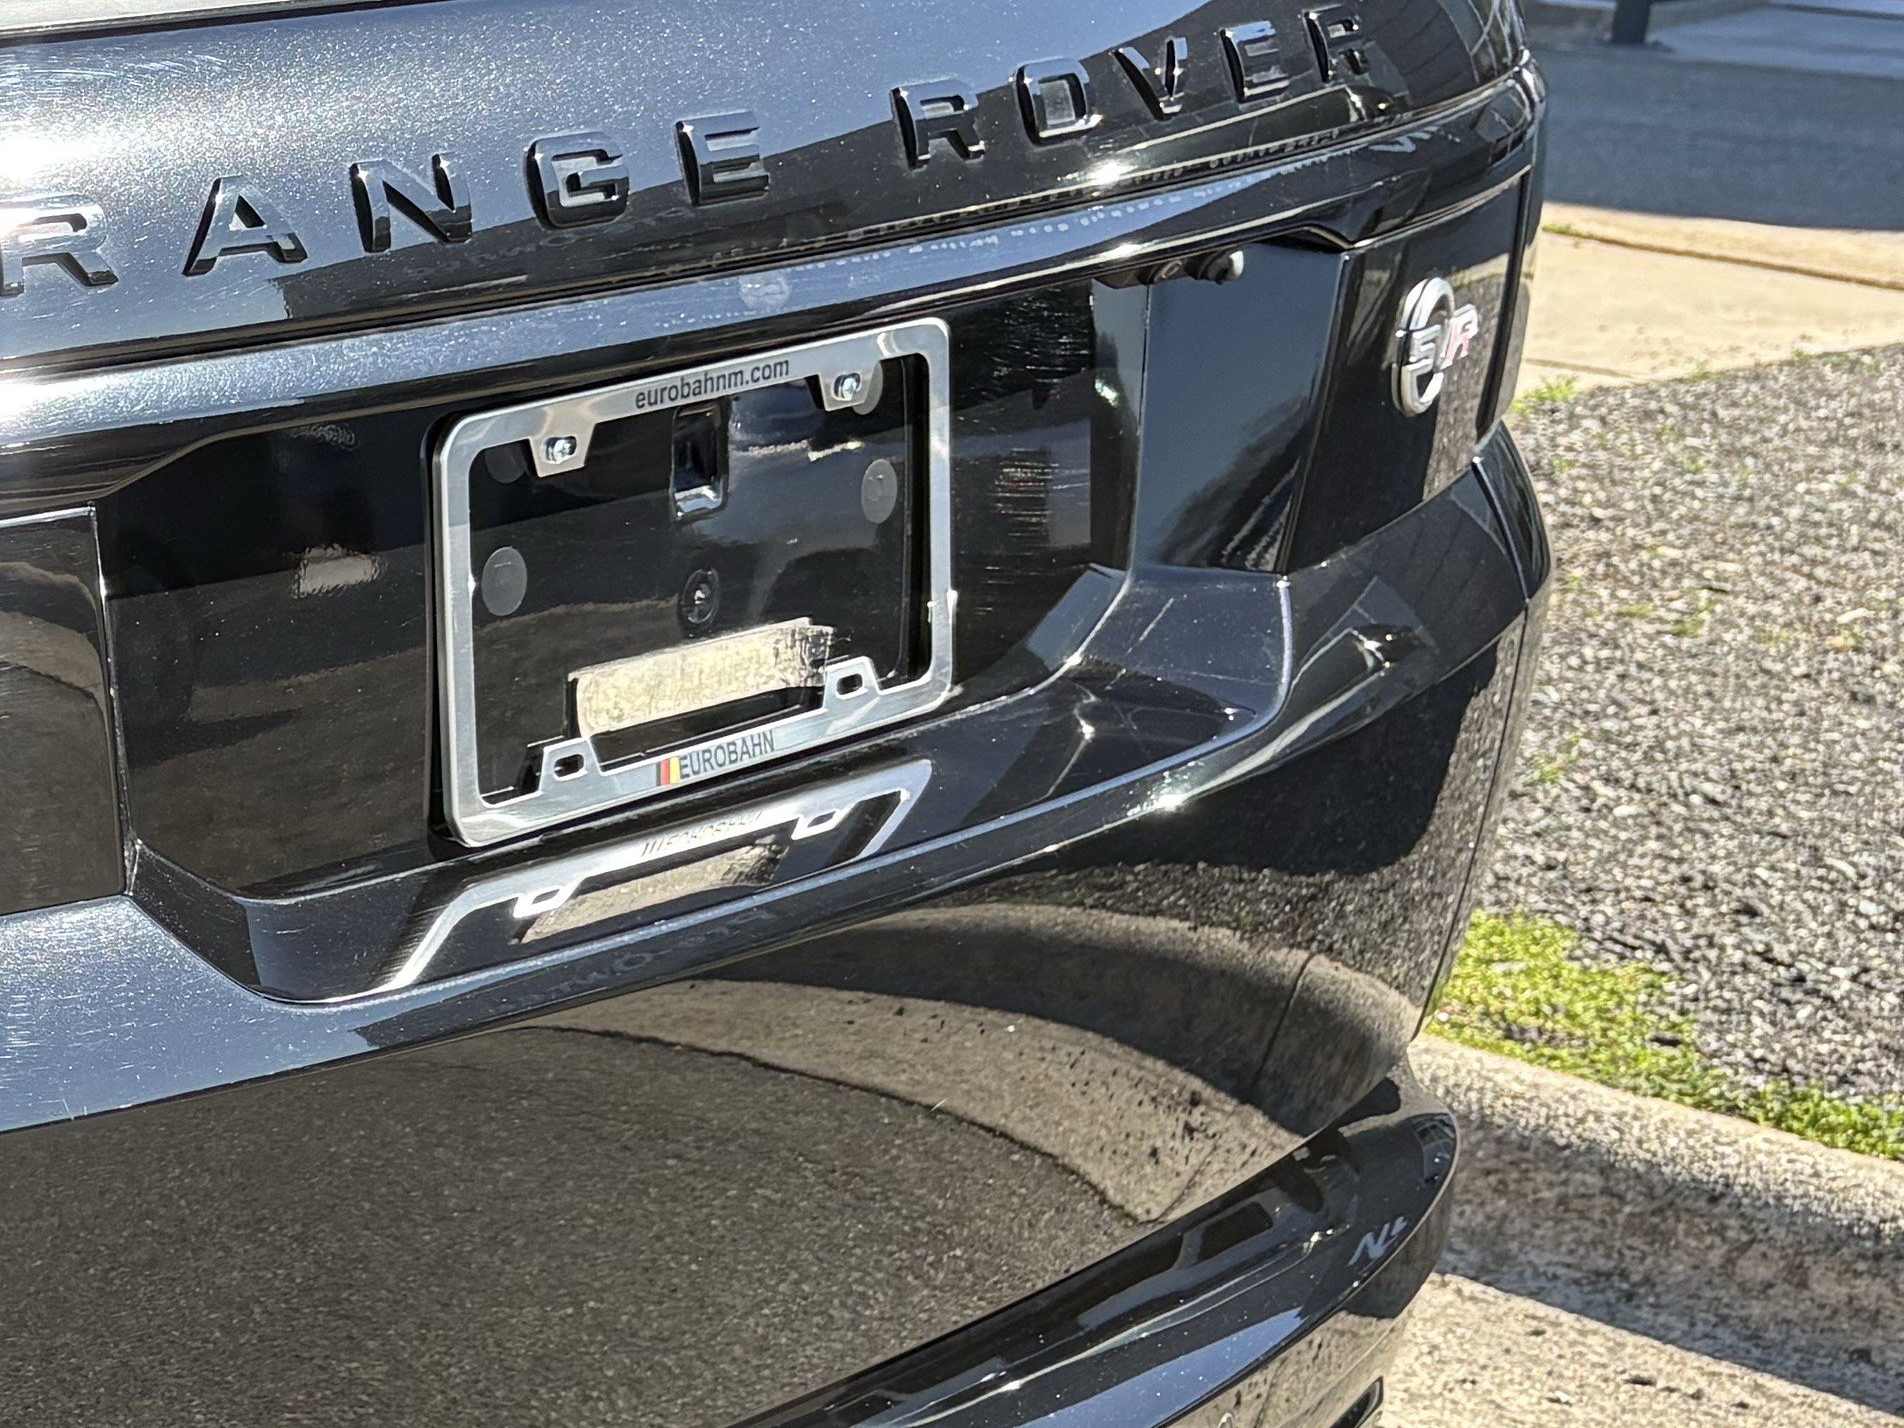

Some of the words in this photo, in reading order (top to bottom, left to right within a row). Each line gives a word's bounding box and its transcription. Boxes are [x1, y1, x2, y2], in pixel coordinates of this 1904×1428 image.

[889, 3, 1366, 172] ROVER
[634, 358, 790, 409] eurobahnm.com
[679, 729, 776, 780] EUROBAHN
